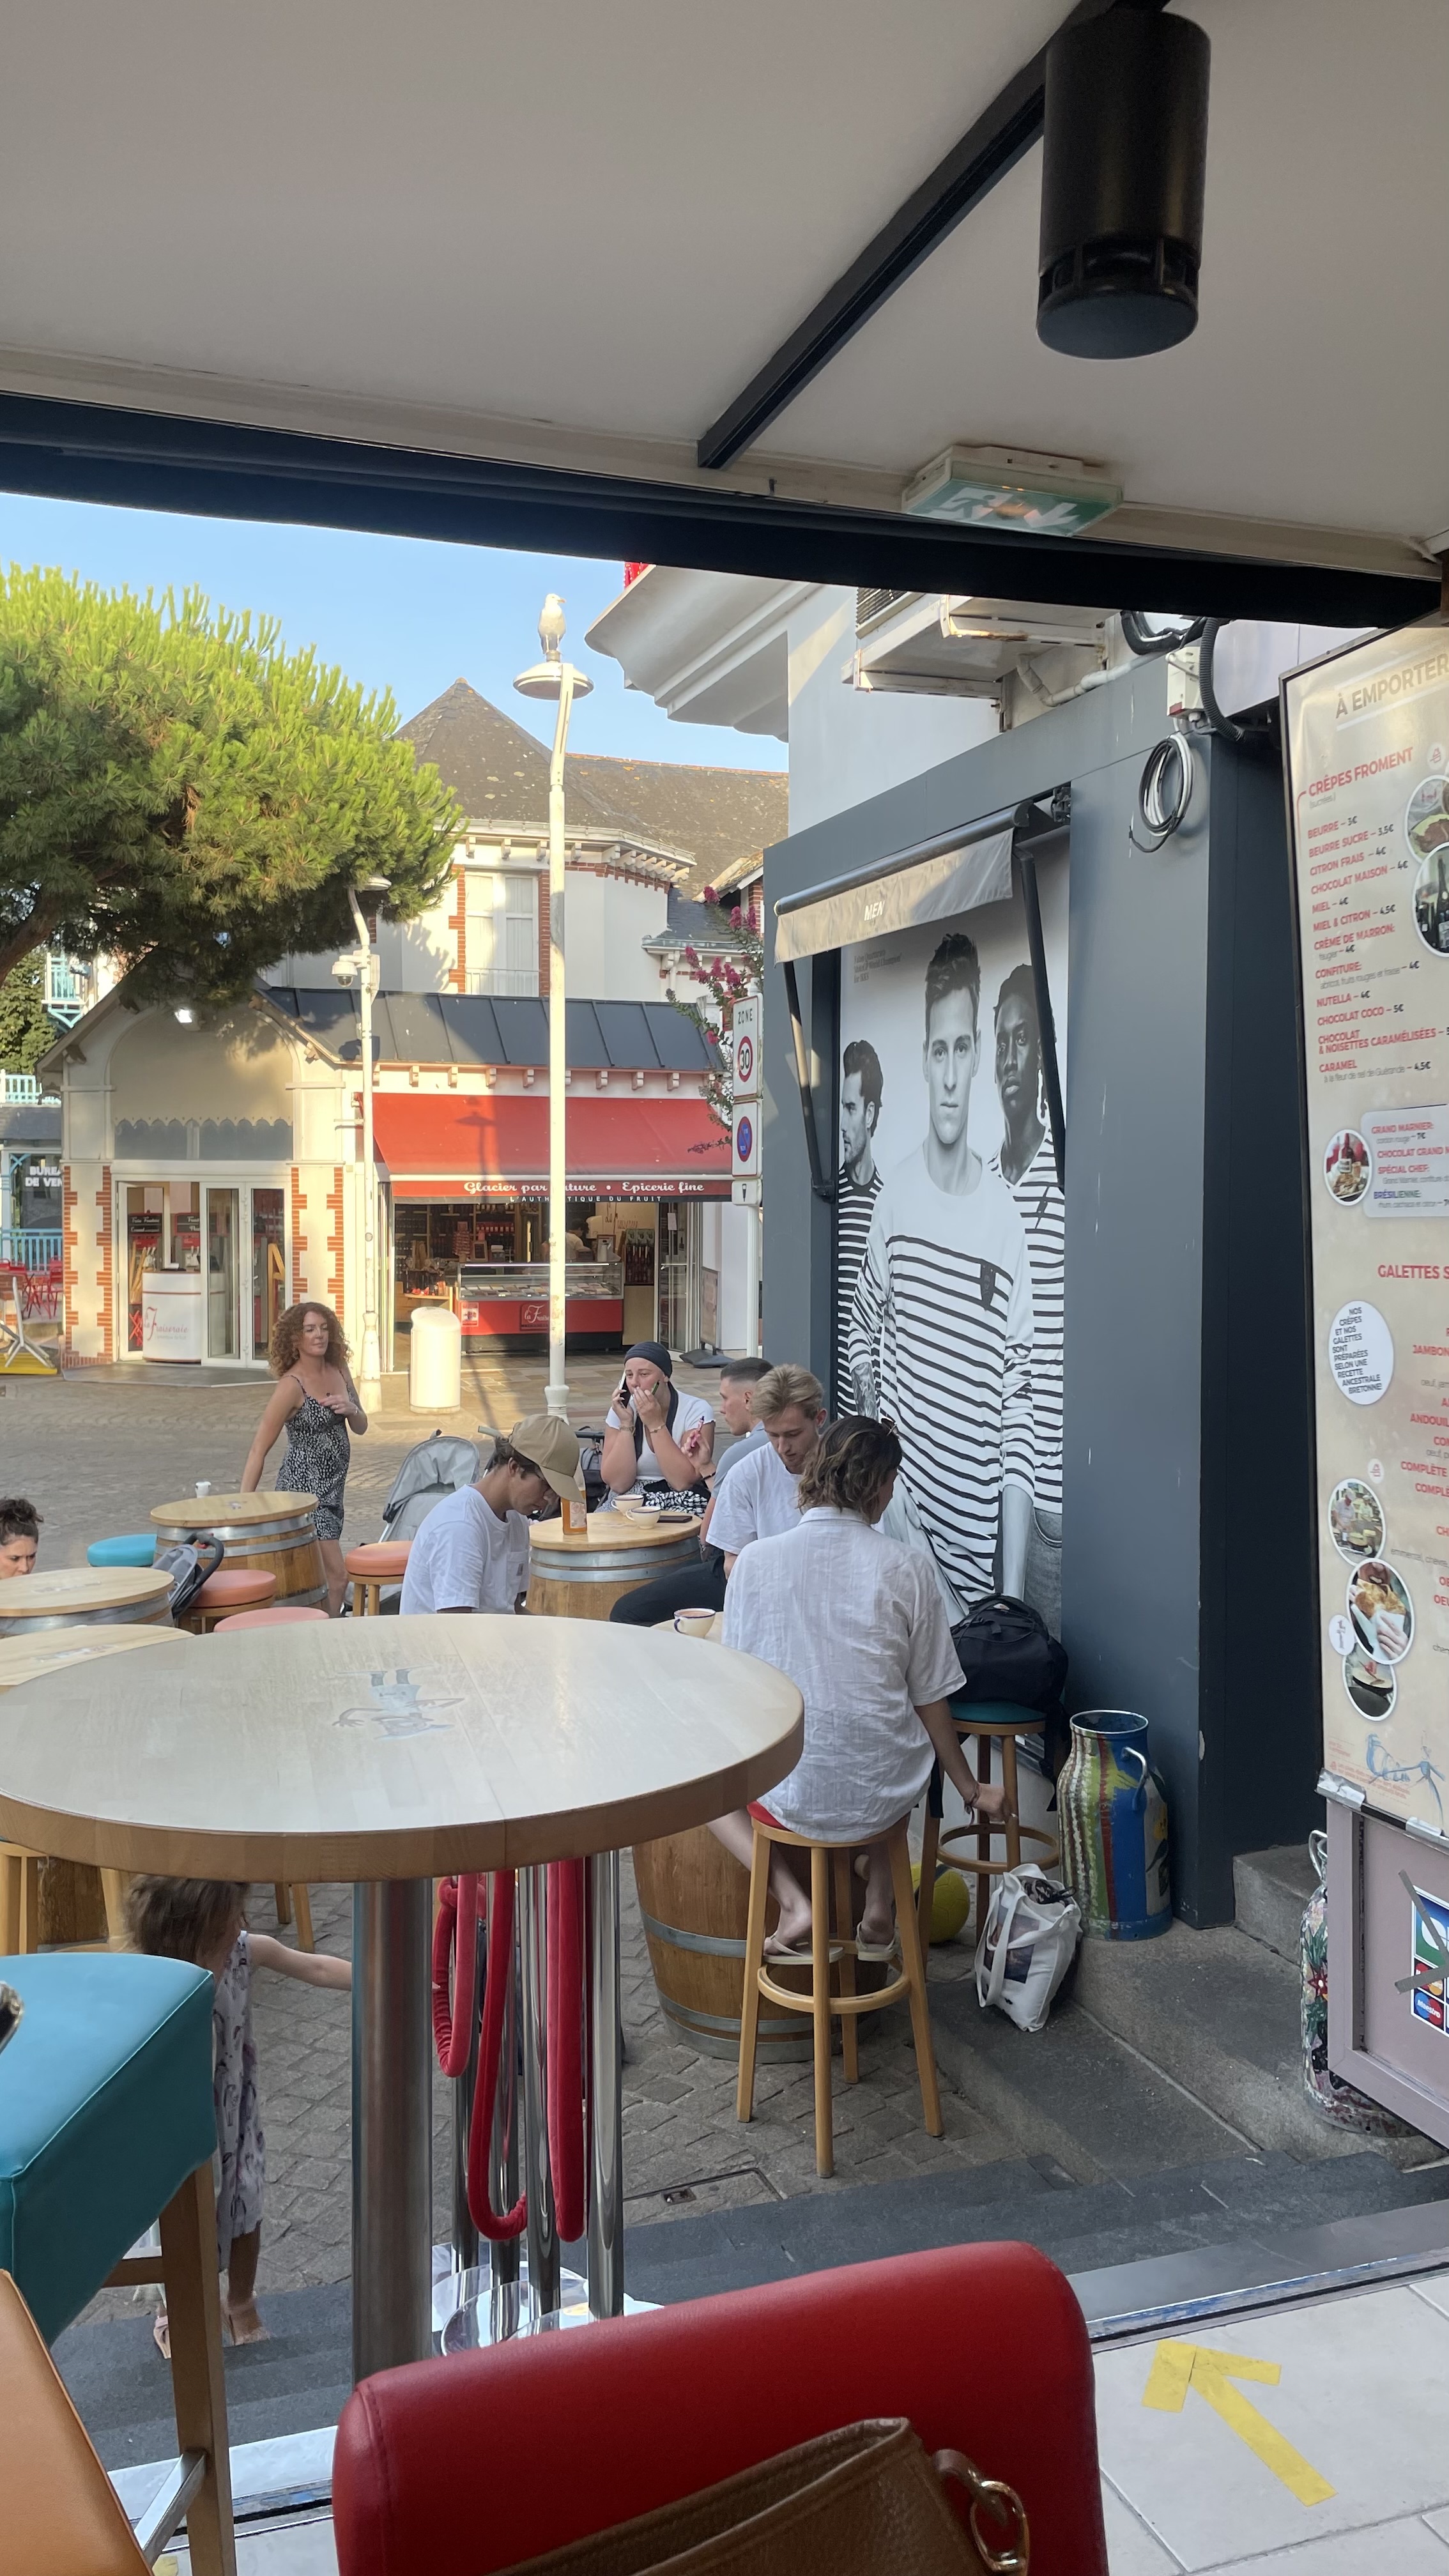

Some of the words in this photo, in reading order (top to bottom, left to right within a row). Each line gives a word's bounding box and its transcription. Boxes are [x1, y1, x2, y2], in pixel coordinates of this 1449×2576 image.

[1308, 770, 1353, 797] CRÊPES
[1354, 747, 1413, 781] FROMENT
[1308, 821, 1339, 839] BEURRE
[1309, 840, 1340, 857] BEURRE
[1310, 860, 1338, 875] CITRON
[1340, 852, 1365, 867] FRAIS
[1311, 875, 1353, 894] CHOCOLAT
[1354, 865, 1388, 883] MAISON
[864, 900, 885, 921] MEN
[1312, 901, 1330, 914] MIEL
[1314, 920, 1331, 932] MIEL
[1340, 910, 1370, 925] CITRON
[1343, 933, 1354, 944] DE
[1317, 993, 1352, 1008] NUTELLA
[738, 1008, 753, 1025] ZONE
[1317, 1010, 1360, 1026] CHOCOLAT
[1361, 1006, 1384, 1018] COCO
[1318, 1029, 1361, 1045] CHOCOLAT
[1326, 1039, 1369, 1054] NOISETTES
[740, 1048, 750, 1070] 30
[1319, 1059, 1358, 1073] CARAMEL
[1377, 1149, 1415, 1158] CHOCOLAT
[25, 1177, 40, 1187] DE
[464, 1182, 517, 1194] Glacier
[521, 1184, 548, 1193] par
[622, 1182, 675, 1193] Epicerie
[678, 1182, 704, 1193] fine
[1377, 1265, 1439, 1279] GALETTES
[1344, 1326, 1356, 1334] NOS
[1333, 1333, 1362, 1344] GALETTES
[1332, 1345, 1347, 1353] SONT
[1335, 1361, 1353, 1370] SELON
[1337, 1368, 1363, 1378] RECETTE
[1342, 1374, 1381, 1386] ANCESTRALE
[1417, 1999, 1441, 2018] Maestro
